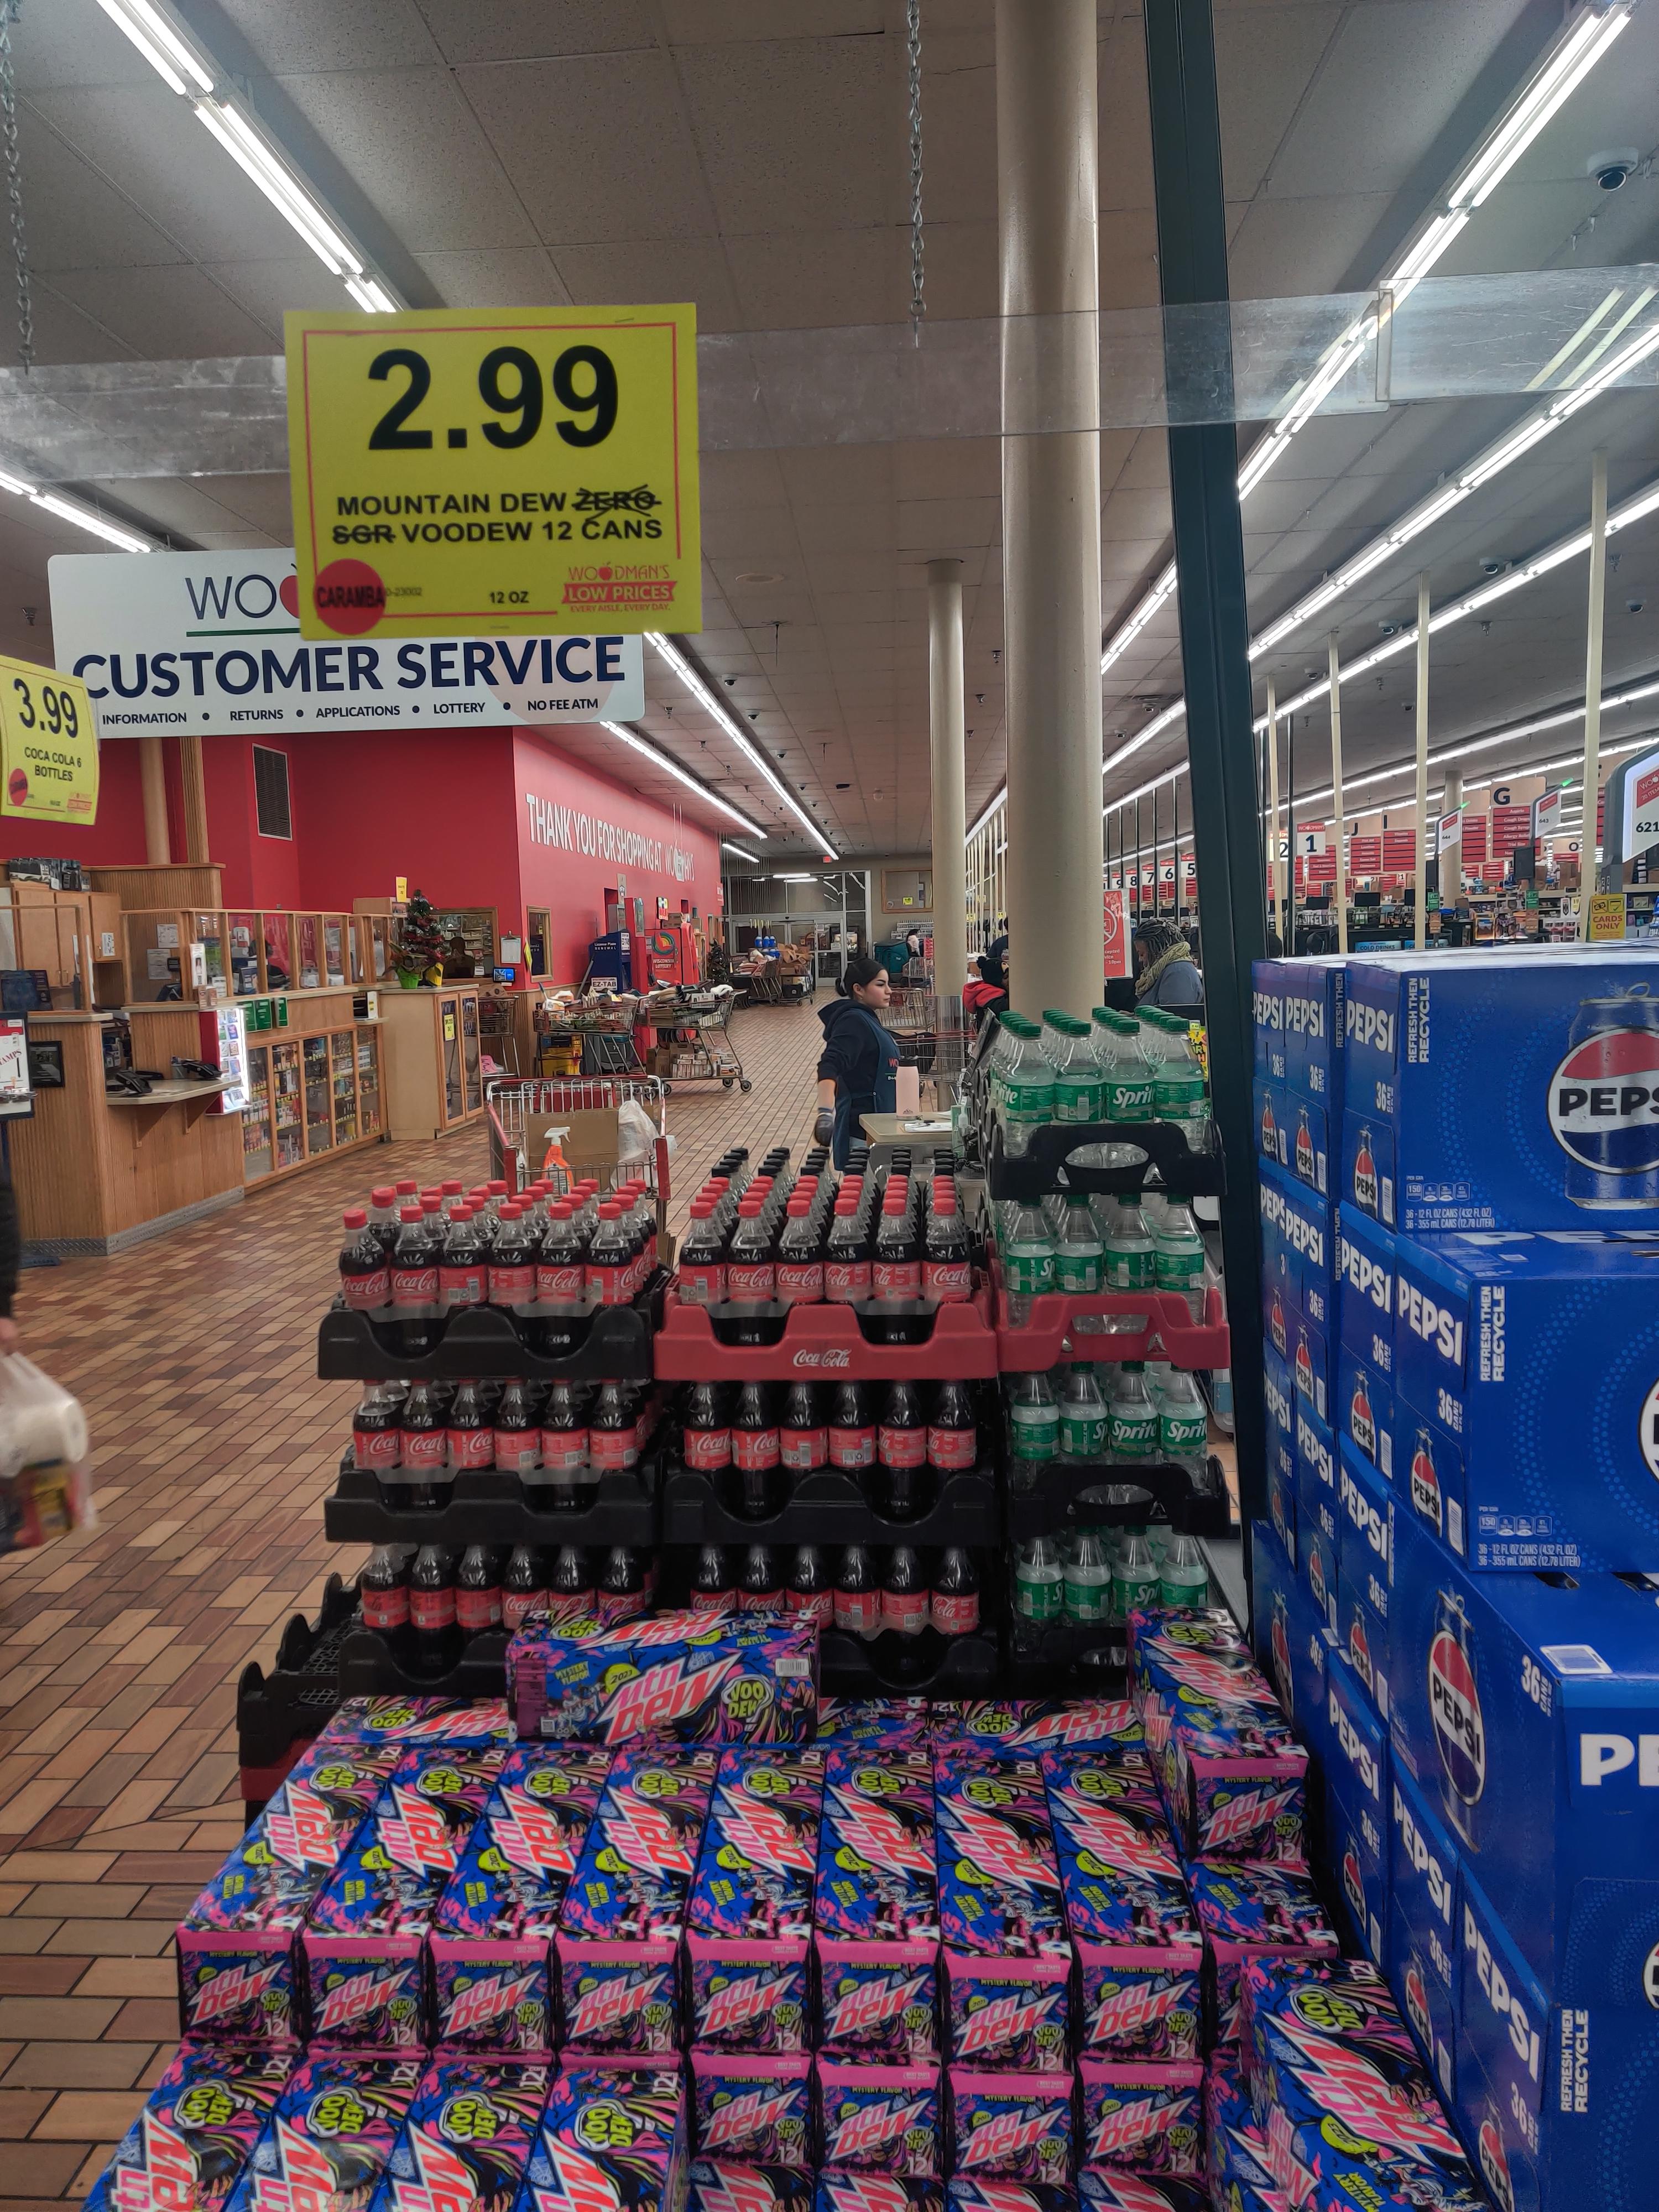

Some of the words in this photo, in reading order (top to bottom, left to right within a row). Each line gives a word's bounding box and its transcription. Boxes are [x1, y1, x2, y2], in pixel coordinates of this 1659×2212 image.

[368, 345, 619, 450] 2.99
[337, 494, 496, 515] MOUNTAIN
[500, 492, 567, 512] DEW
[402, 521, 533, 543] VOODEW
[542, 521, 572, 541] 12
[582, 519, 662, 540] CANS
[316, 585, 385, 609] CARAMBA
[489, 591, 505, 604] 12
[509, 591, 529, 604] OZ
[568, 585, 608, 602] LOW
[612, 583, 670, 601] PRICES
[73, 646, 384, 699] CUSTOMER
[397, 637, 625, 689] SERVICE
[13, 677, 79, 738] 3.99
[102, 712, 187, 726] INFORMATION
[229, 709, 284, 721] RETURNS
[316, 705, 400, 719] APPLICATIONS
[433, 702, 486, 714] LOTTERY
[528, 700, 546, 711] NO
[549, 698, 570, 711] FEE
[571, 698, 598, 709] ATM
[24, 747, 50, 761] COCA
[52, 752, 75, 767] COLA
[77, 757, 82, 768] 6
[34, 764, 73, 782] BOTTLES
[1493, 787, 1511, 805] G
[1647, 787, 1659, 797] ITEM
[525, 792, 573, 852] THANK
[572, 810, 596, 858] YOU
[597, 818, 617, 863] FOR
[615, 826, 655, 872] SHOPPING
[653, 839, 663, 874] AT
[1351, 822, 1359, 836] J
[1636, 821, 1659, 833] 621
[1279, 841, 1288, 858] 2
[1305, 834, 1317, 853] 1
[1130, 876, 1137, 886] 8
[1146, 872, 1155, 884] 7
[1165, 867, 1174, 880] 6
[1187, 863, 1196, 876] 5
[1593, 915, 1623, 924] CARDS
[1595, 922, 1620, 930] ONLY
[1335, 972, 1343, 1002] THEN
[1408, 978, 1417, 1009] THEN
[1253, 990, 1284, 1030] PEPSI
[1286, 996, 1324, 1038] PEPSI
[1335, 1003, 1344, 1048] REFRESH
[1346, 999, 1394, 1053] PEPSI
[1420, 977, 1430, 1063] RECYCLE
[1407, 1011, 1417, 1063] REFRESH
[0, 1048, 22, 1065] TAMPS
[1309, 1064, 1318, 1092] 36
[1112, 1086, 1155, 1109] Sprit
[1376, 1081, 1386, 1112] 36
[1356, 1177, 1376, 1201] PEPSI
[1260, 1182, 1286, 1231] PEPS
[1426, 1209, 1433, 1218] FL
[1433, 1208, 1442, 1218] OZ
[1441, 1208, 1458, 1218] CANS
[1473, 1207, 1481, 1218] FL
[1285, 1207, 1323, 1267] PEPSI
[1441, 1218, 1457, 1228] CANS
[1341, 1237, 1391, 1314] PEPSI
[1309, 1288, 1318, 1318] 36
[1480, 1286, 1491, 1322] THEN
[1398, 1274, 1463, 1366] PEPSI
[1493, 1285, 1505, 1382] RECYCLE
[1373, 1334, 1384, 1367] 36
[1479, 1323, 1491, 1382] REFRESH
[1438, 1387, 1453, 1426] 36
[1354, 1417, 1375, 1451] PEPSI
[1297, 1412, 1334, 1489] PEPSI
[1340, 1464, 1388, 1562] PEPSI
[1521, 1655, 1541, 1704] 36
[1433, 1670, 1482, 1765] PEPSI
[1329, 1688, 1379, 1802] PEPSI
[1393, 1781, 1451, 1926] PEPSI
[1464, 1901, 1540, 2084] PEPSI
[1562, 2009, 1574, 2047] THEN
[1575, 2009, 1589, 2114] RECYCLE
[1561, 2049, 1573, 2112] REFRESH
